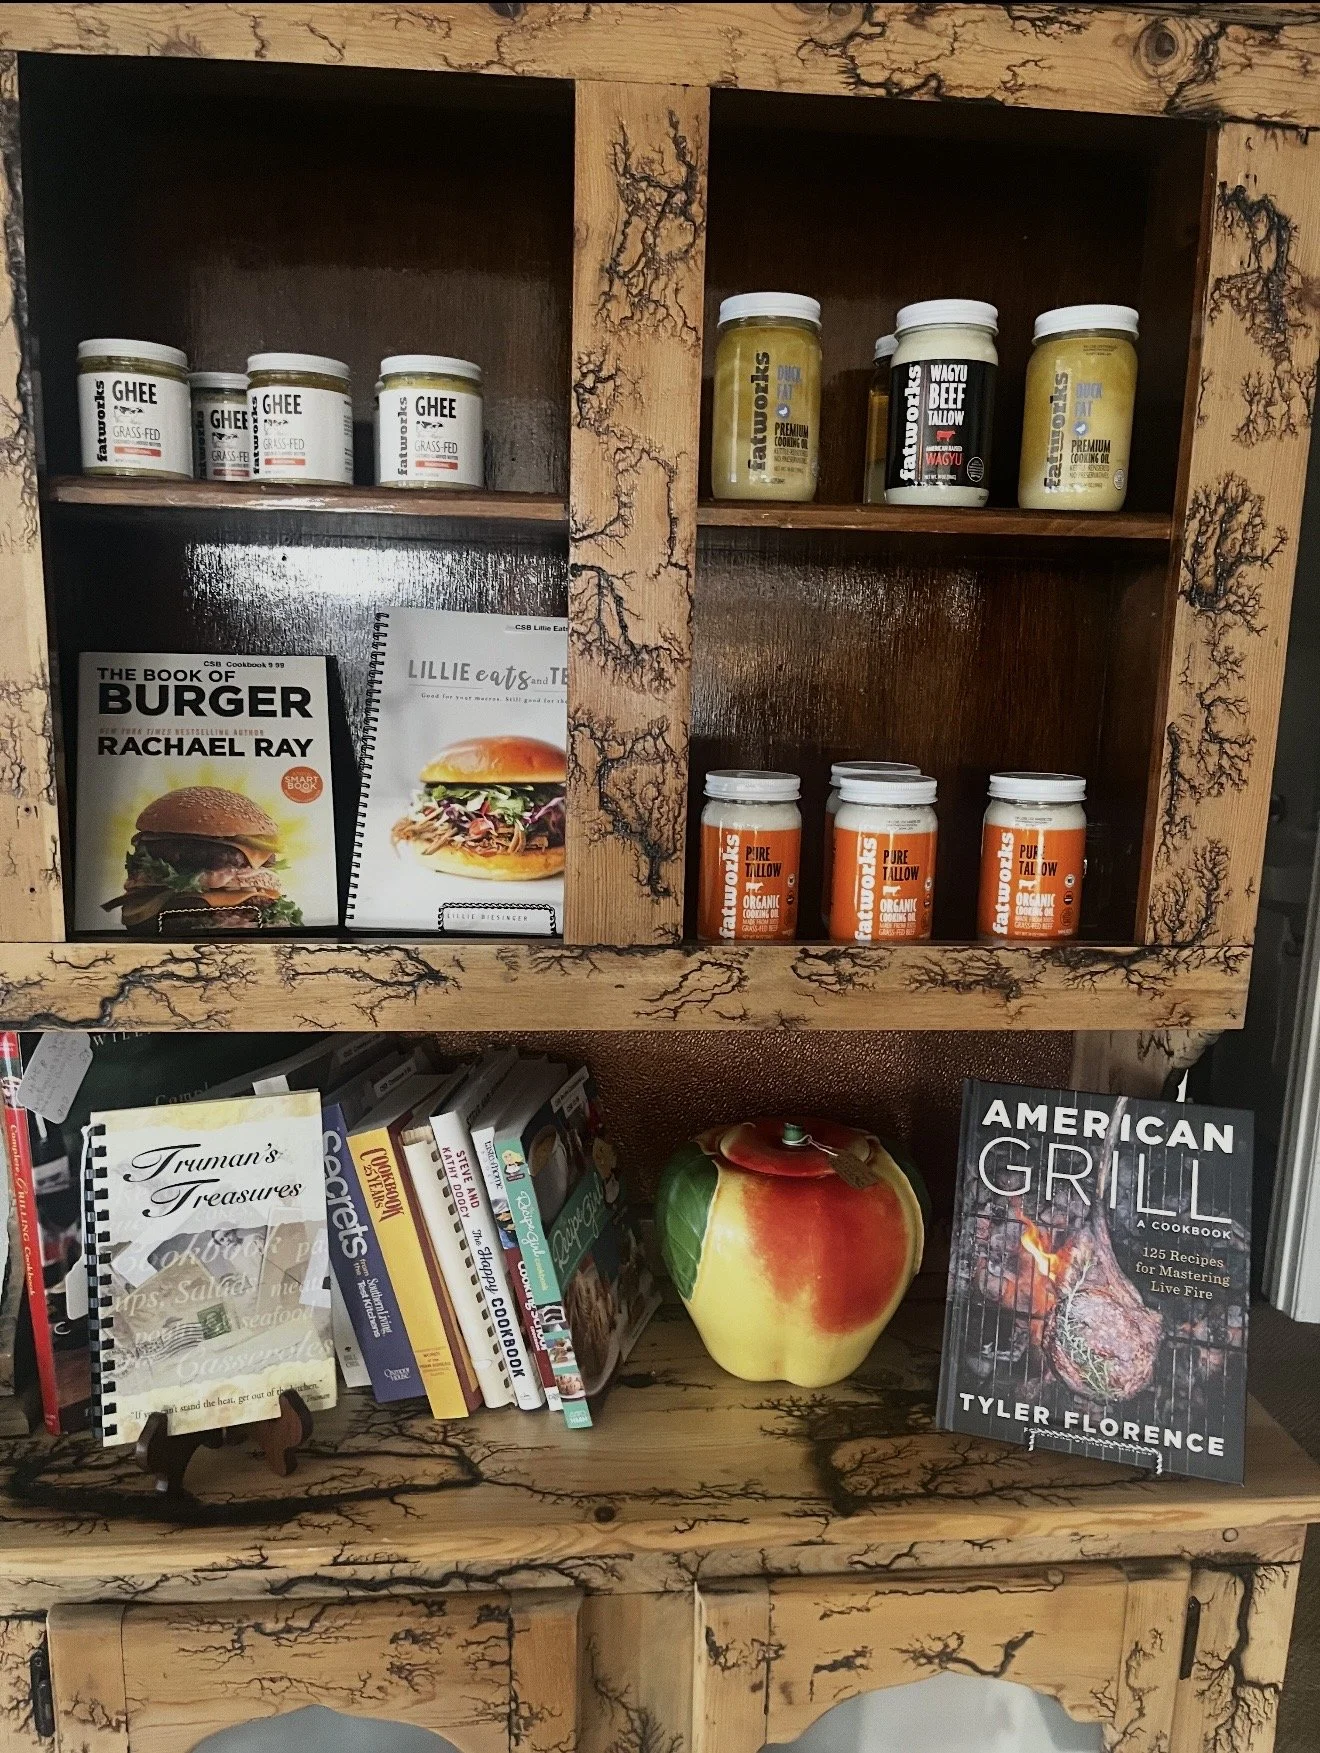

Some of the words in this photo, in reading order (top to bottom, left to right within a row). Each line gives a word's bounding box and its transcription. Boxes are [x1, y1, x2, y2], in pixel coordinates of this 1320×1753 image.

[930, 364, 968, 382] WAGYU
[112, 380, 158, 404] GHEE
[928, 383, 966, 409] BEEF
[262, 394, 303, 415] GHEE
[415, 396, 457, 418] GHEE
[748, 352, 769, 471] fatworks
[95, 380, 107, 462] fatworks
[210, 409, 248, 430] GHEE
[900, 364, 922, 481] fatworks
[927, 410, 965, 426] TALLOW
[112, 425, 161, 441] GRASS-FED
[251, 396, 260, 475] fatworks
[398, 396, 408, 476] fatworks
[774, 422, 809, 437] PREMIUM
[1044, 371, 1069, 490] fatworks
[263, 438, 305, 450] GRASS-FED
[415, 440, 458, 454] GRASS-FED
[1071, 439, 1111, 453] PREMIUM
[212, 450, 249, 463] GRASS-FE
[926, 452, 963, 466] WAGYU
[1070, 452, 1098, 464] COOKING
[97, 667, 137, 681] THE
[143, 669, 203, 682] BOOK
[208, 670, 236, 682] OF
[408, 660, 471, 681] LILLIE
[475, 665, 531, 691] eats
[531, 676, 549, 685] and
[98, 682, 314, 719] BURGER
[97, 736, 245, 757] RACHAEL
[254, 738, 314, 757] RAY
[287, 782, 318, 790] BOOK
[746, 846, 771, 861] PURE
[883, 850, 909, 865] PURE
[745, 862, 782, 877] TALLOW
[882, 866, 920, 881] TALLOW
[719, 834, 740, 939] fatworks
[854, 837, 878, 941] fatworks
[992, 832, 1015, 935] fatworks
[743, 895, 780, 909] ORGANIC
[880, 898, 917, 913] ORGANIC
[1016, 891, 1055, 907] ORGANIC
[981, 1099, 1234, 1154] AMERICAN
[123, 1142, 280, 1183] Truman's
[363, 1164, 372, 1176] 25
[360, 1148, 404, 1222] COOKBOOK
[367, 1169, 385, 1209] YEARS
[442, 1147, 458, 1179] KATHY
[453, 1184, 470, 1219] DOOCY
[456, 1150, 473, 1183] STEVE
[467, 1187, 480, 1209] AND
[978, 1137, 1232, 1224] GRILL
[142, 1178, 304, 1218] Treasures
[1137, 1219, 1145, 1229] A
[1151, 1221, 1232, 1240] COOKBOOK
[360, 1258, 370, 1277] from
[1142, 1247, 1167, 1259] 125
[1169, 1249, 1224, 1268] Recipes
[353, 1262, 361, 1276] the
[1135, 1261, 1155, 1276] for
[1158, 1265, 1231, 1288] Mastering
[357, 1279, 368, 1299] Test
[1150, 1280, 1181, 1295] Live
[1184, 1285, 1214, 1300] Fire
[471, 1229, 482, 1246] The
[478, 1246, 498, 1295] Happy
[491, 1297, 526, 1378] COOKBOOK
[362, 1298, 381, 1339] Kitchens
[180, 1400, 201, 1412] stand
[203, 1399, 215, 1408] the
[238, 1394, 249, 1404] get
[251, 1392, 264, 1400] out
[266, 1388, 276, 1397] of
[959, 1392, 1049, 1425] TYLER
[1064, 1411, 1225, 1457] FLORENCE
